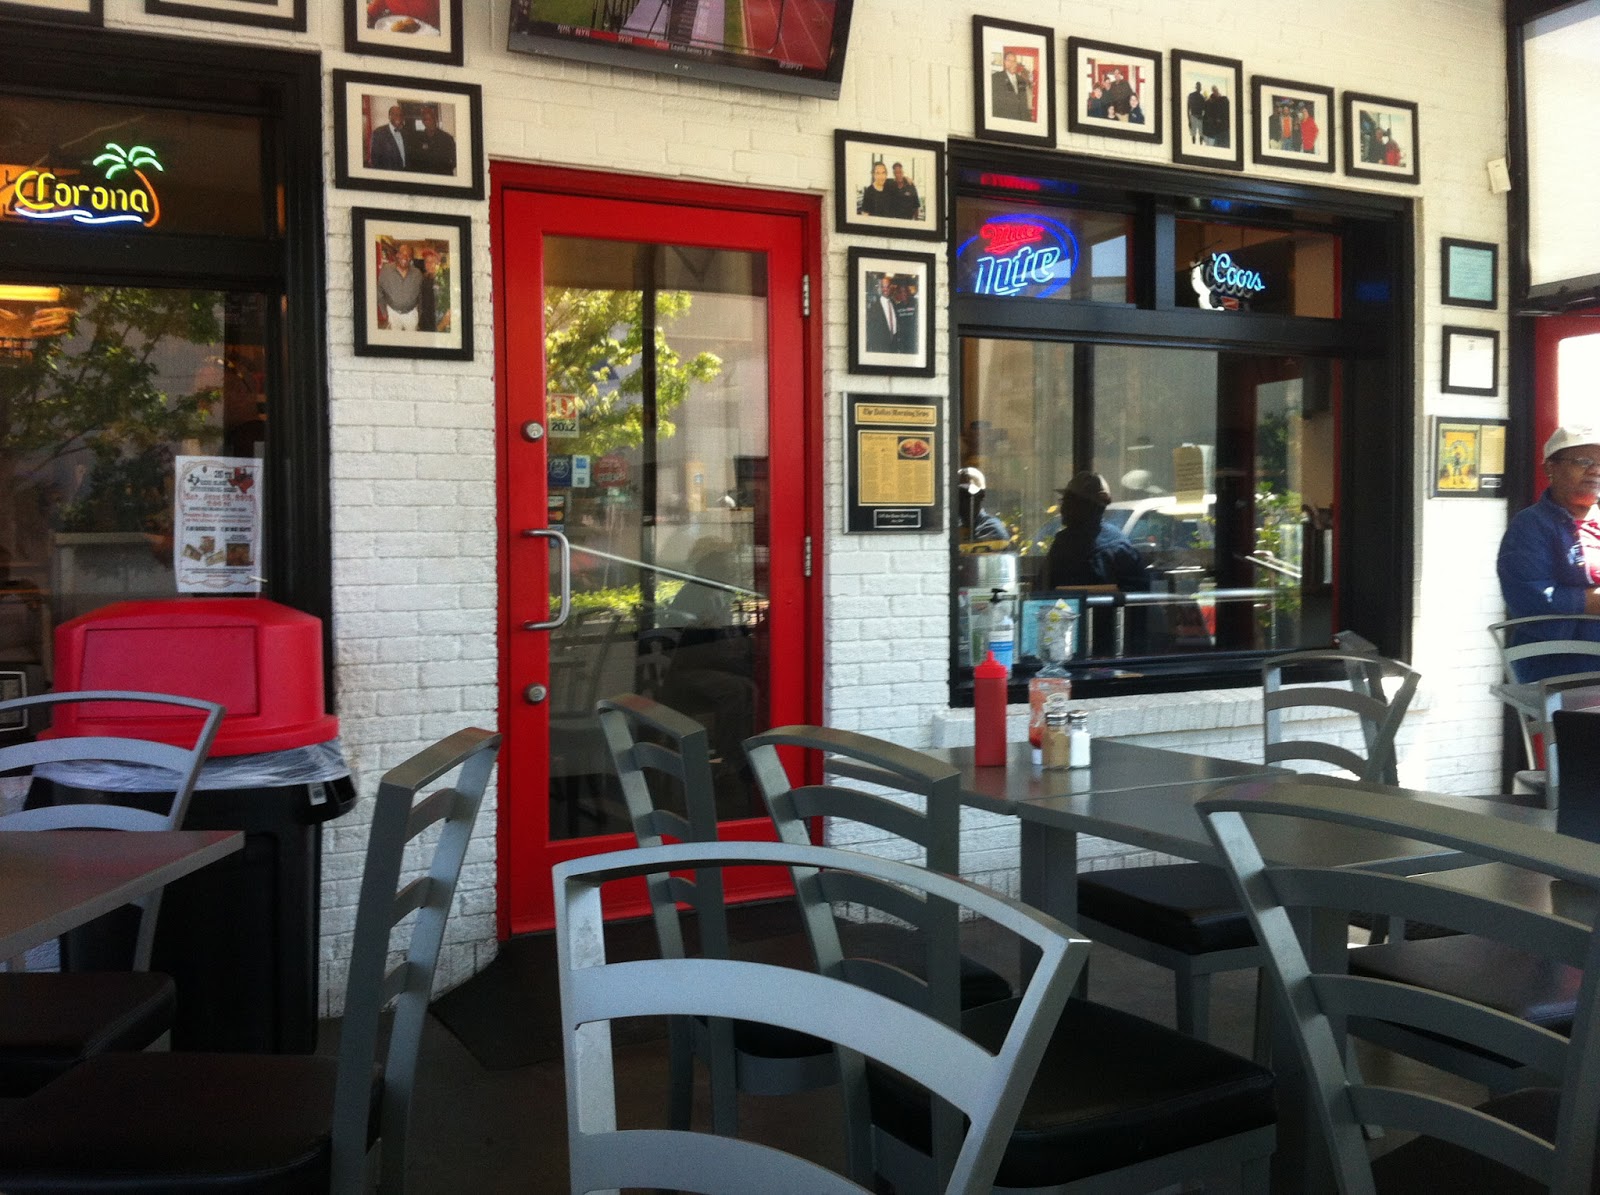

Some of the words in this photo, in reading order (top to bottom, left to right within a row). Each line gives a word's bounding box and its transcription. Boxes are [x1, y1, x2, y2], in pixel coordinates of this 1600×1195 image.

[15, 170, 149, 212] Corona
[975, 246, 1060, 296] Lite
[1212, 252, 1266, 291] Coors
[551, 422, 576, 432] 2012
